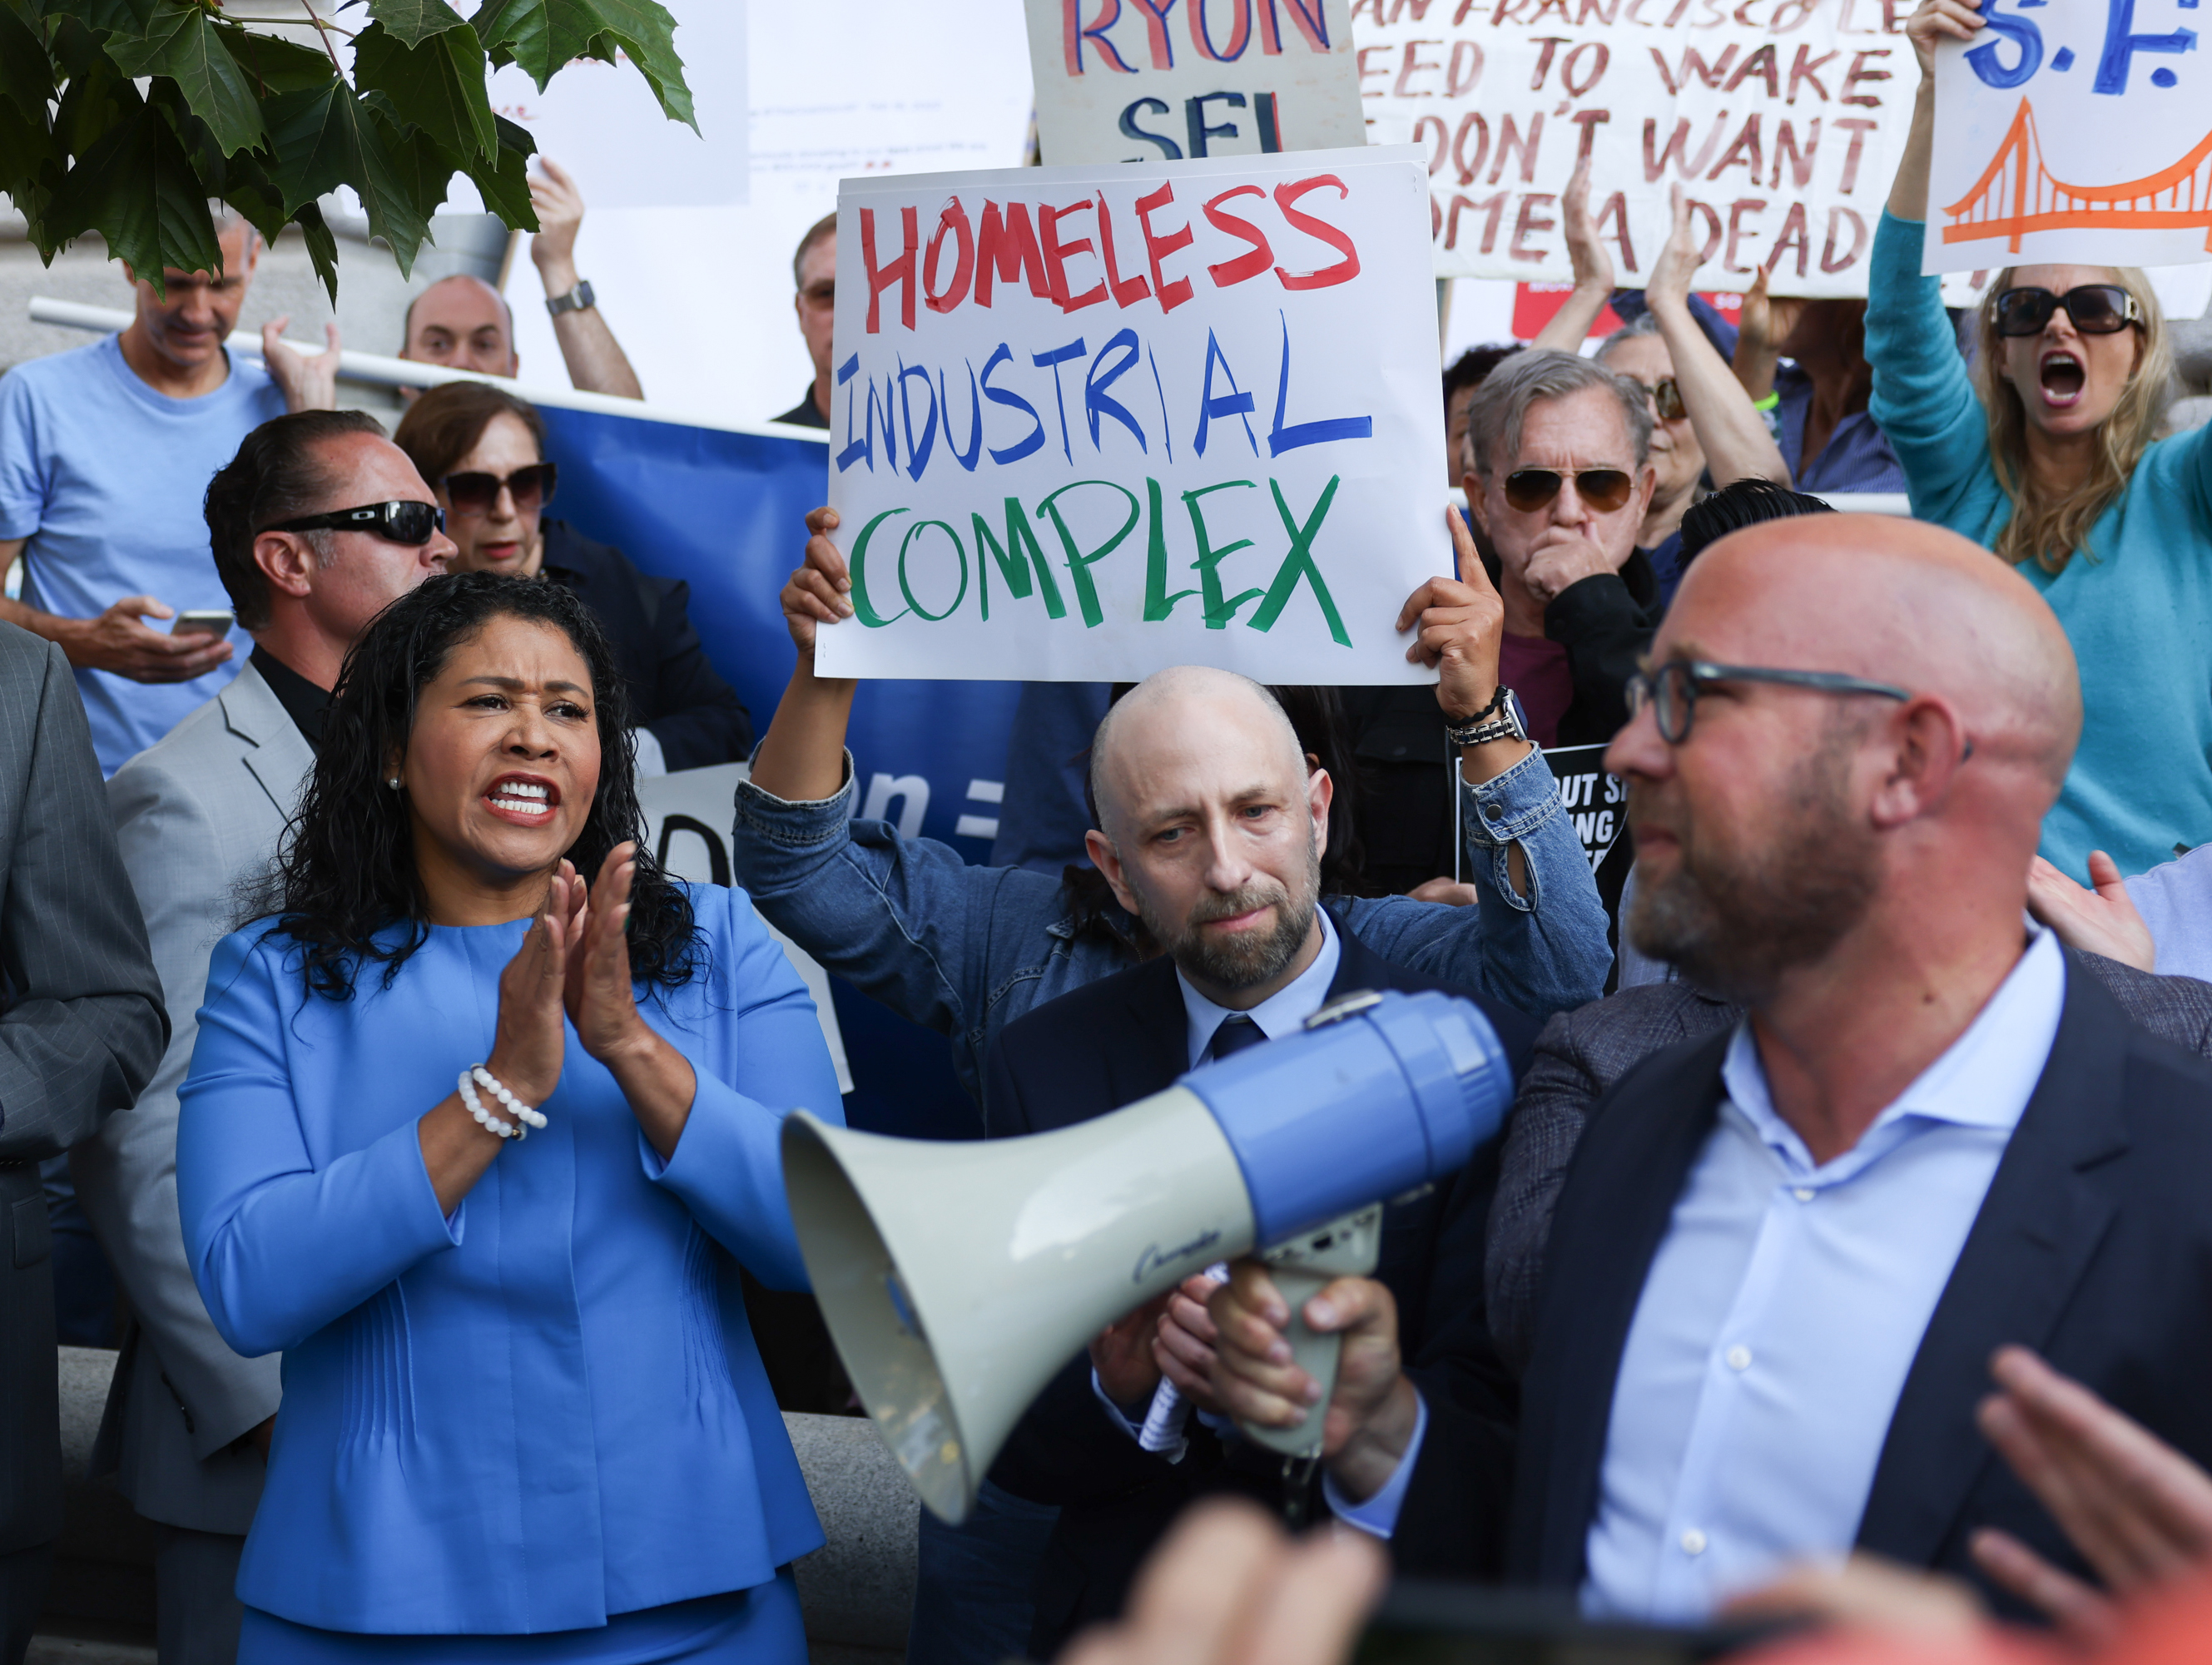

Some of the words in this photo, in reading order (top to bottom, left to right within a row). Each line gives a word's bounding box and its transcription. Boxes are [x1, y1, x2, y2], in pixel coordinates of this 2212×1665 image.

[1528, 37, 1610, 97] TO
[1648, 43, 1892, 107] WAKE
[1643, 110, 1877, 195] WANT
[860, 174, 1361, 334] HOMELESS
[1430, 190, 1557, 264] ME
[1686, 199, 1869, 278] DEAD
[836, 309, 1372, 483] INDUSTRIAL
[850, 474, 1353, 648] COMPLEX
[1554, 772, 1599, 809] UT
